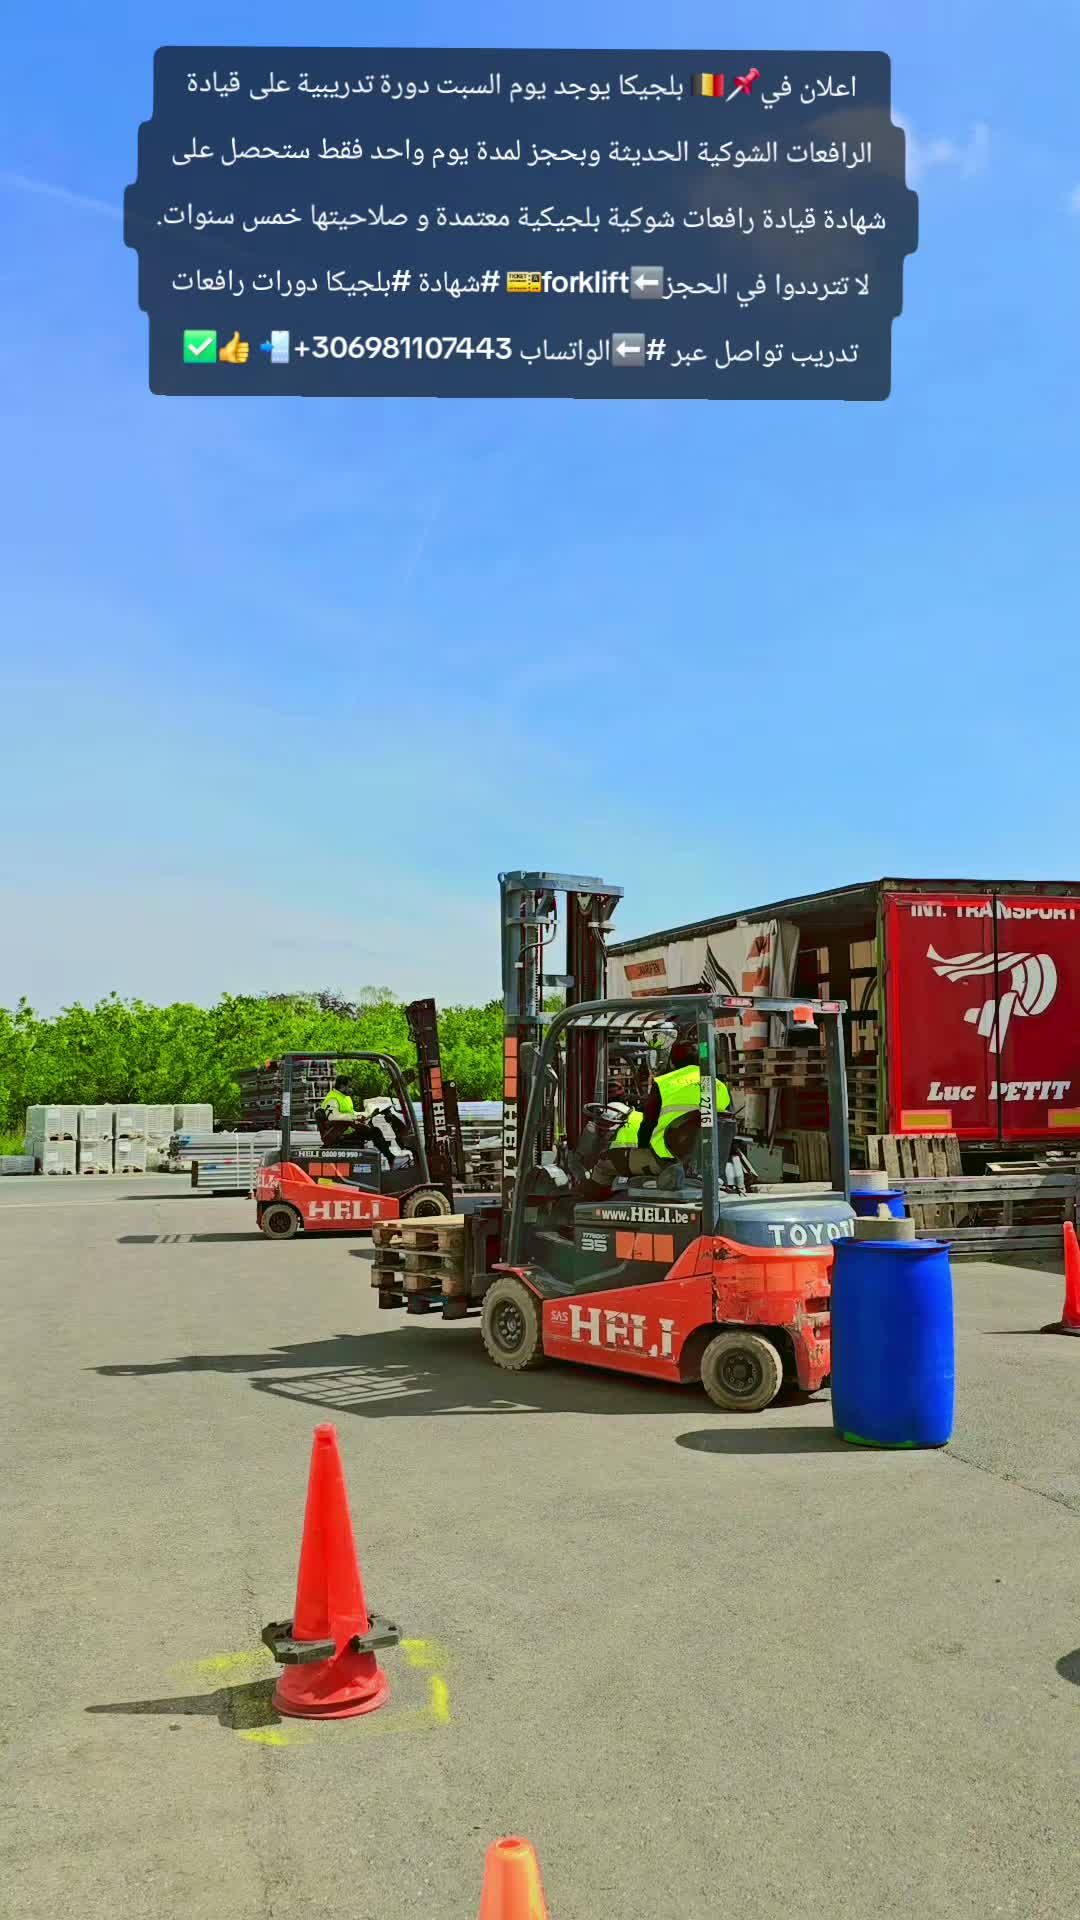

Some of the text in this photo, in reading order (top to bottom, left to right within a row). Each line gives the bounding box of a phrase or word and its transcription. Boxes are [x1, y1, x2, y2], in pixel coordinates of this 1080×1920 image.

[927, 1081, 1071, 1101] Luc PETIT
[700, 1097, 712, 1124] 2716
[298, 1150, 320, 1158] HELI
[308, 1200, 380, 1220] HELI
[601, 1206, 689, 1223] www.HELI.be
[581, 1239, 608, 1252] 35
[551, 1310, 569, 1321] SAS
